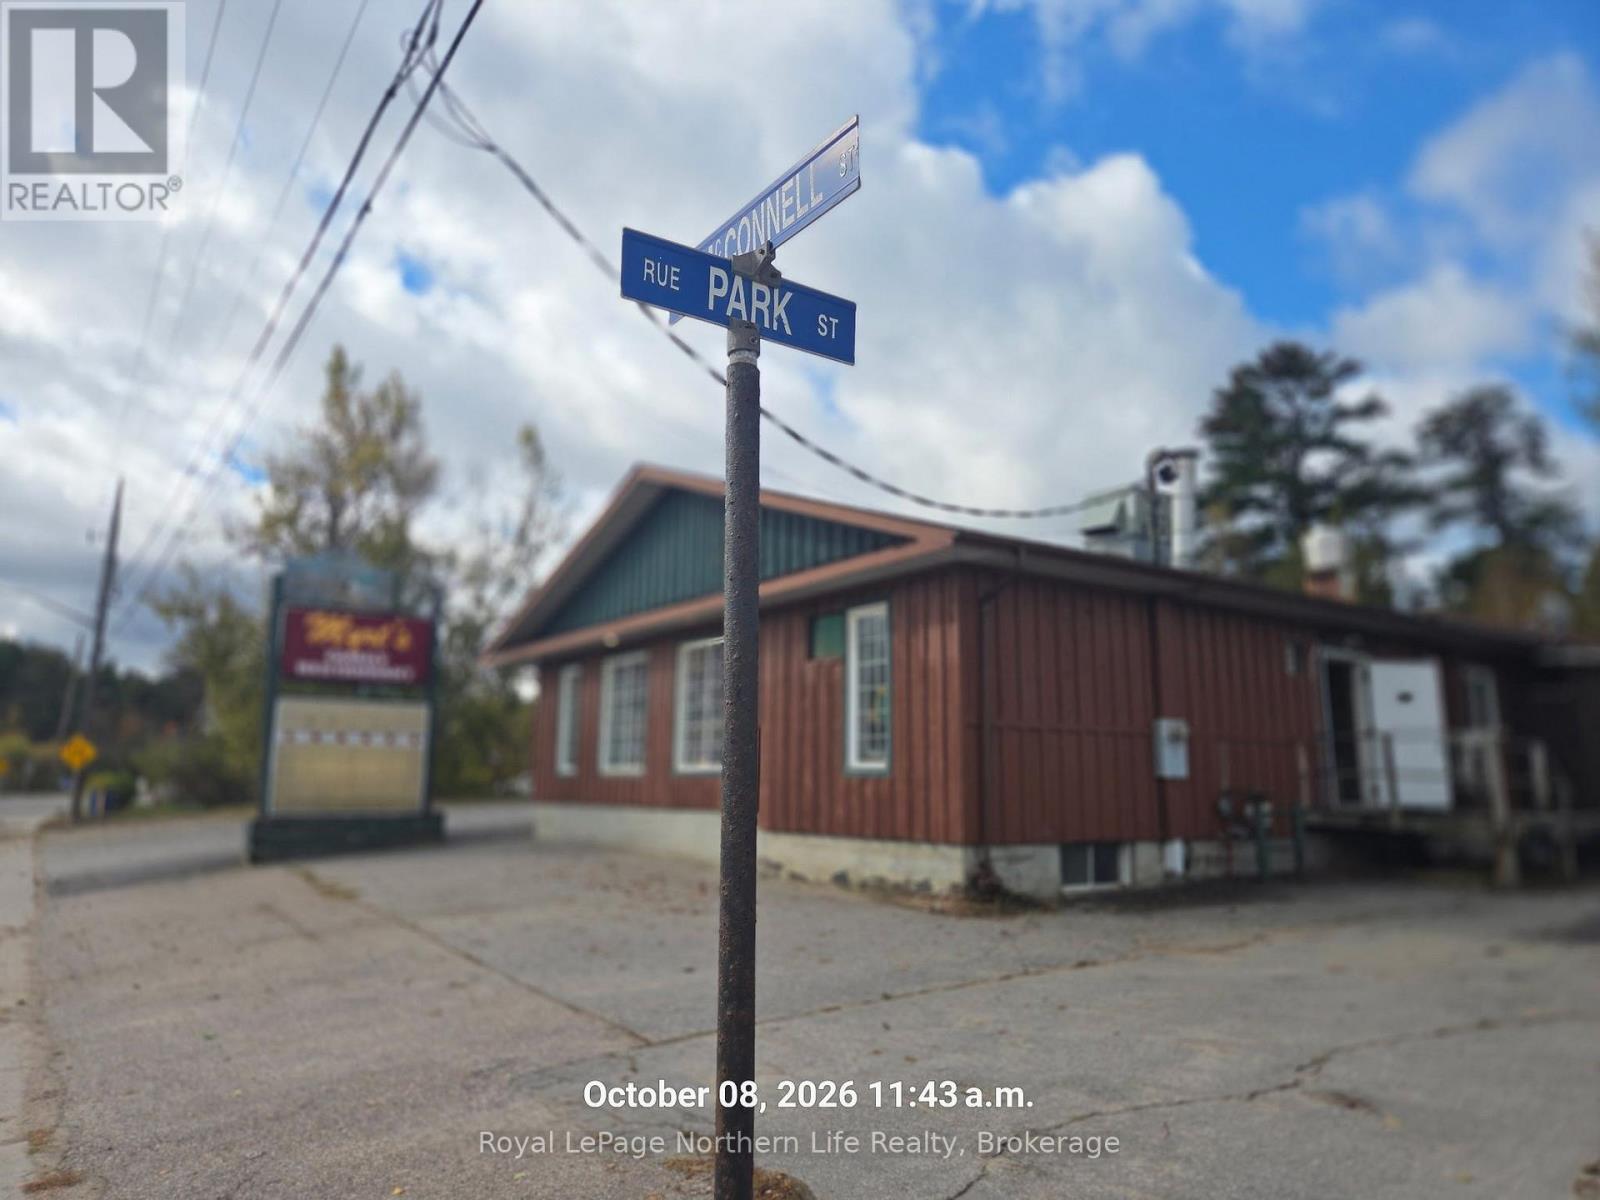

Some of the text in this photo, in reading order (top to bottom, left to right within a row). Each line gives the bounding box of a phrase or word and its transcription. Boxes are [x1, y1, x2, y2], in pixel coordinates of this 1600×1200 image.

[839, 145, 857, 178] ST
[643, 258, 839, 339] RUE PARK ST
